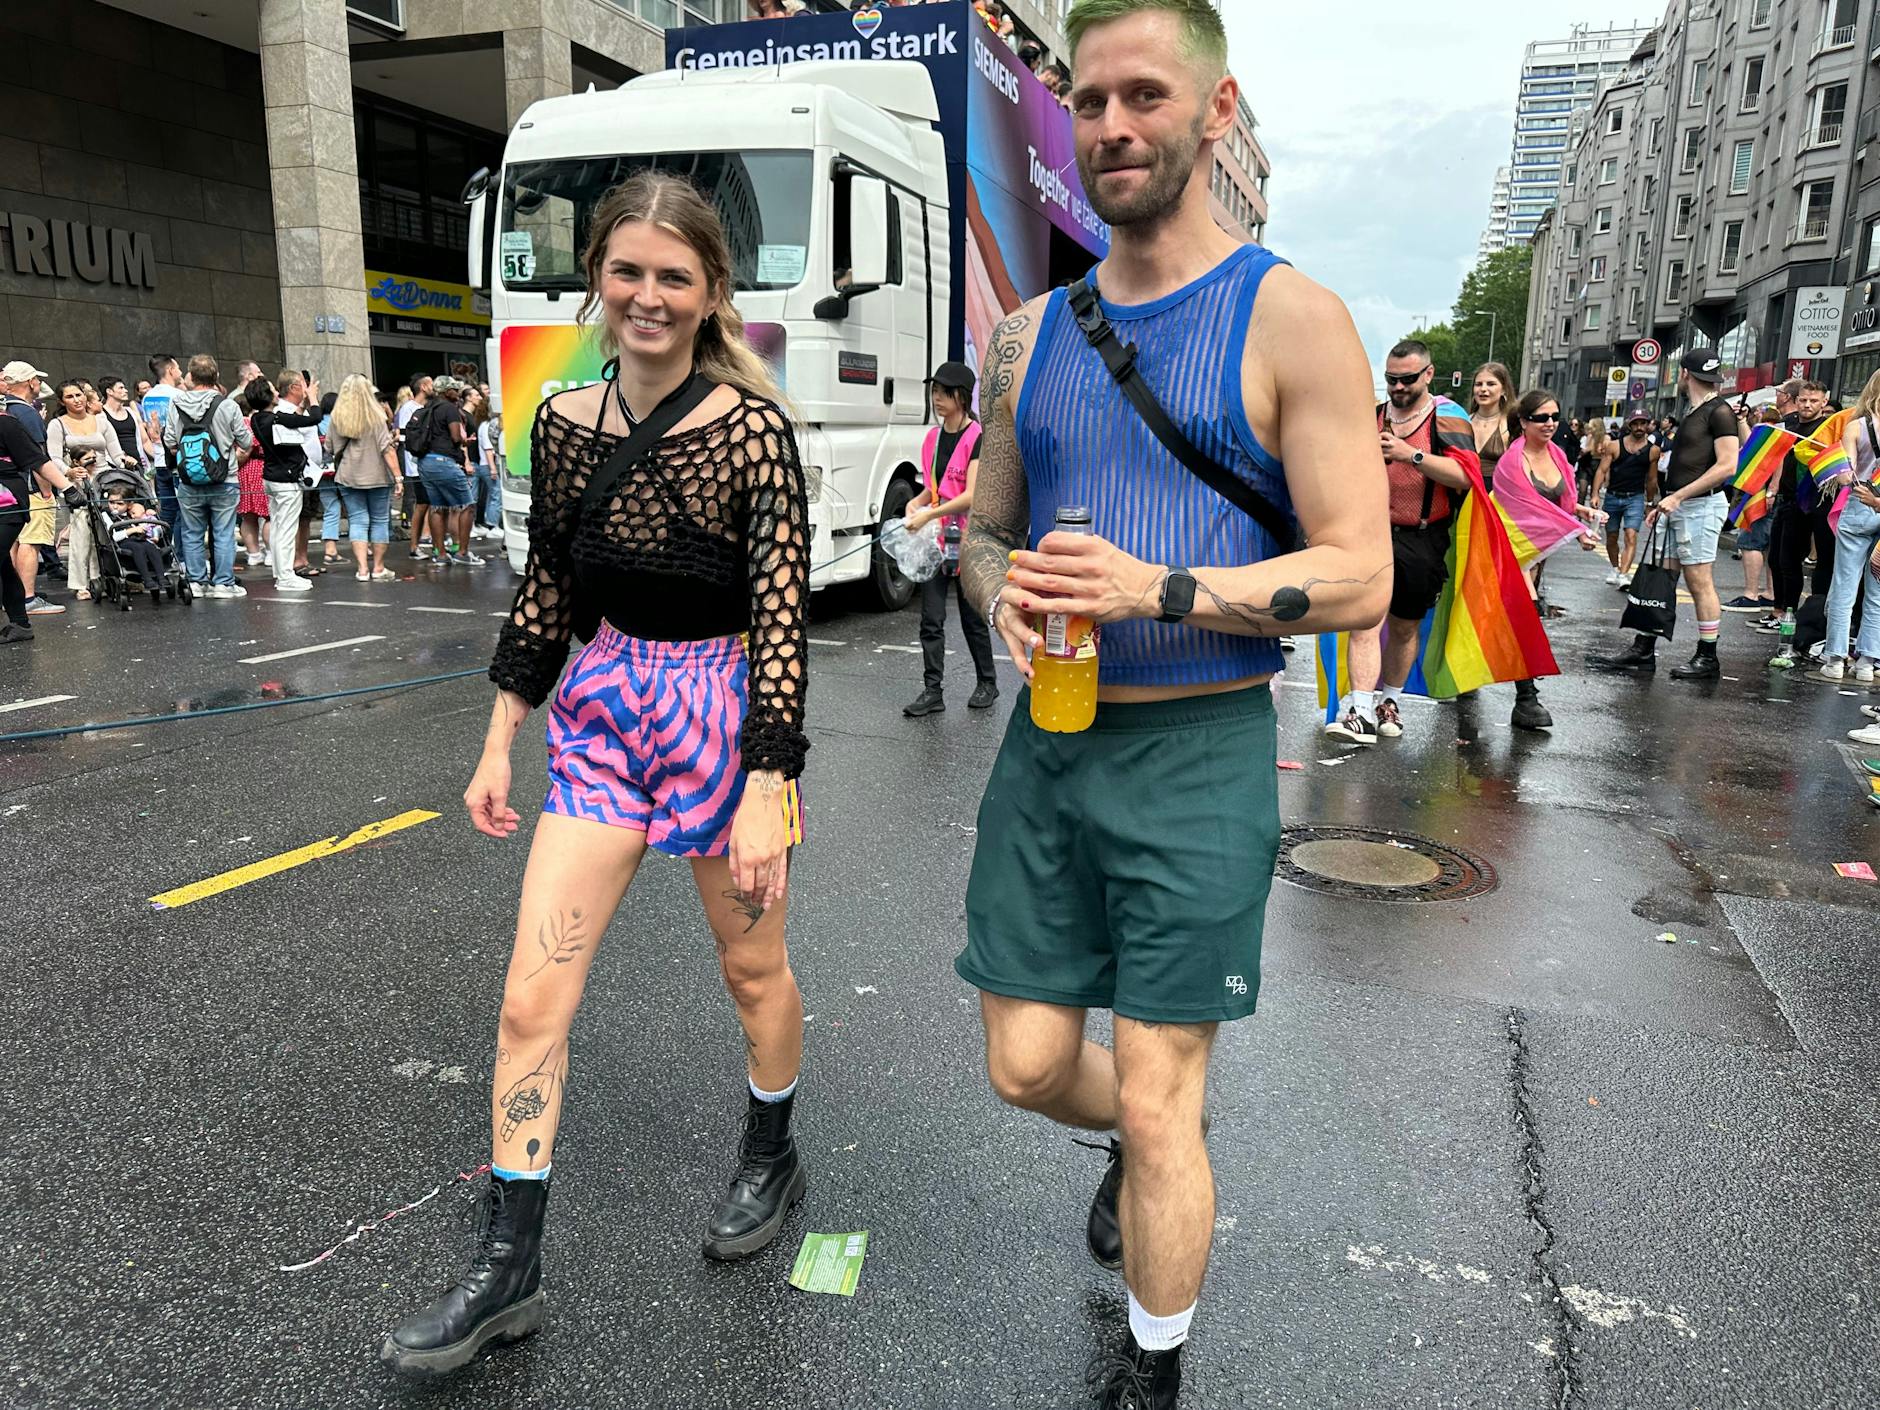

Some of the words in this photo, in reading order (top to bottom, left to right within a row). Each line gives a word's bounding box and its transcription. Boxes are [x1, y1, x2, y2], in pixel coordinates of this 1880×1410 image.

[674, 38, 861, 71] Gemeinsam
[870, 24, 957, 60] stark
[974, 37, 1020, 104] SIEMENS
[1028, 145, 1070, 212] Together
[1071, 197, 1083, 223] we
[1797, 324, 1839, 332] VIETNAMESE
[1639, 345, 1655, 358] 30
[1641, 599, 1667, 609] TASCHE
